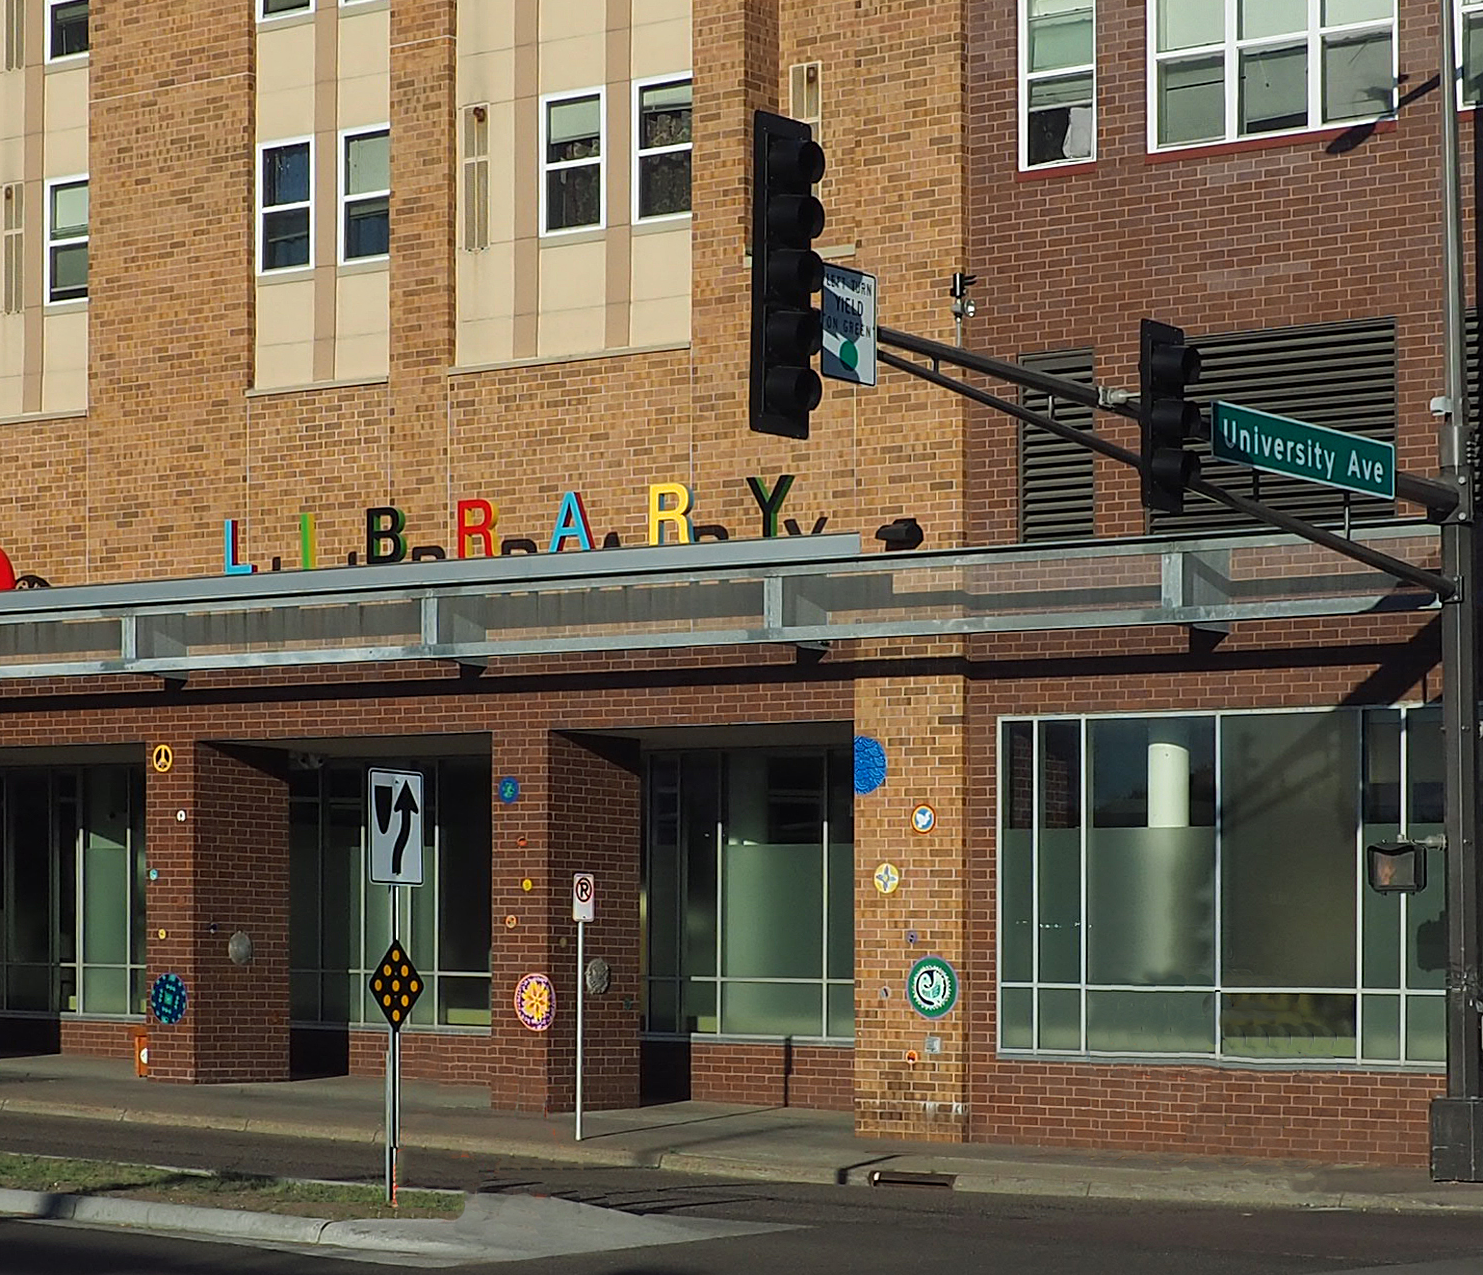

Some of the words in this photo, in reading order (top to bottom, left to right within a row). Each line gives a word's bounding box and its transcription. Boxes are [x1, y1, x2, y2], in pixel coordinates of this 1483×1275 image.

[826, 273, 845, 289] LEFT
[851, 279, 872, 296] TURN
[837, 296, 864, 316] YIELD
[826, 316, 838, 329] ON
[843, 320, 872, 338] GREEN
[1223, 418, 1335, 480] University
[1347, 450, 1384, 484] Ave
[224, 474, 795, 575] LIBRARY
